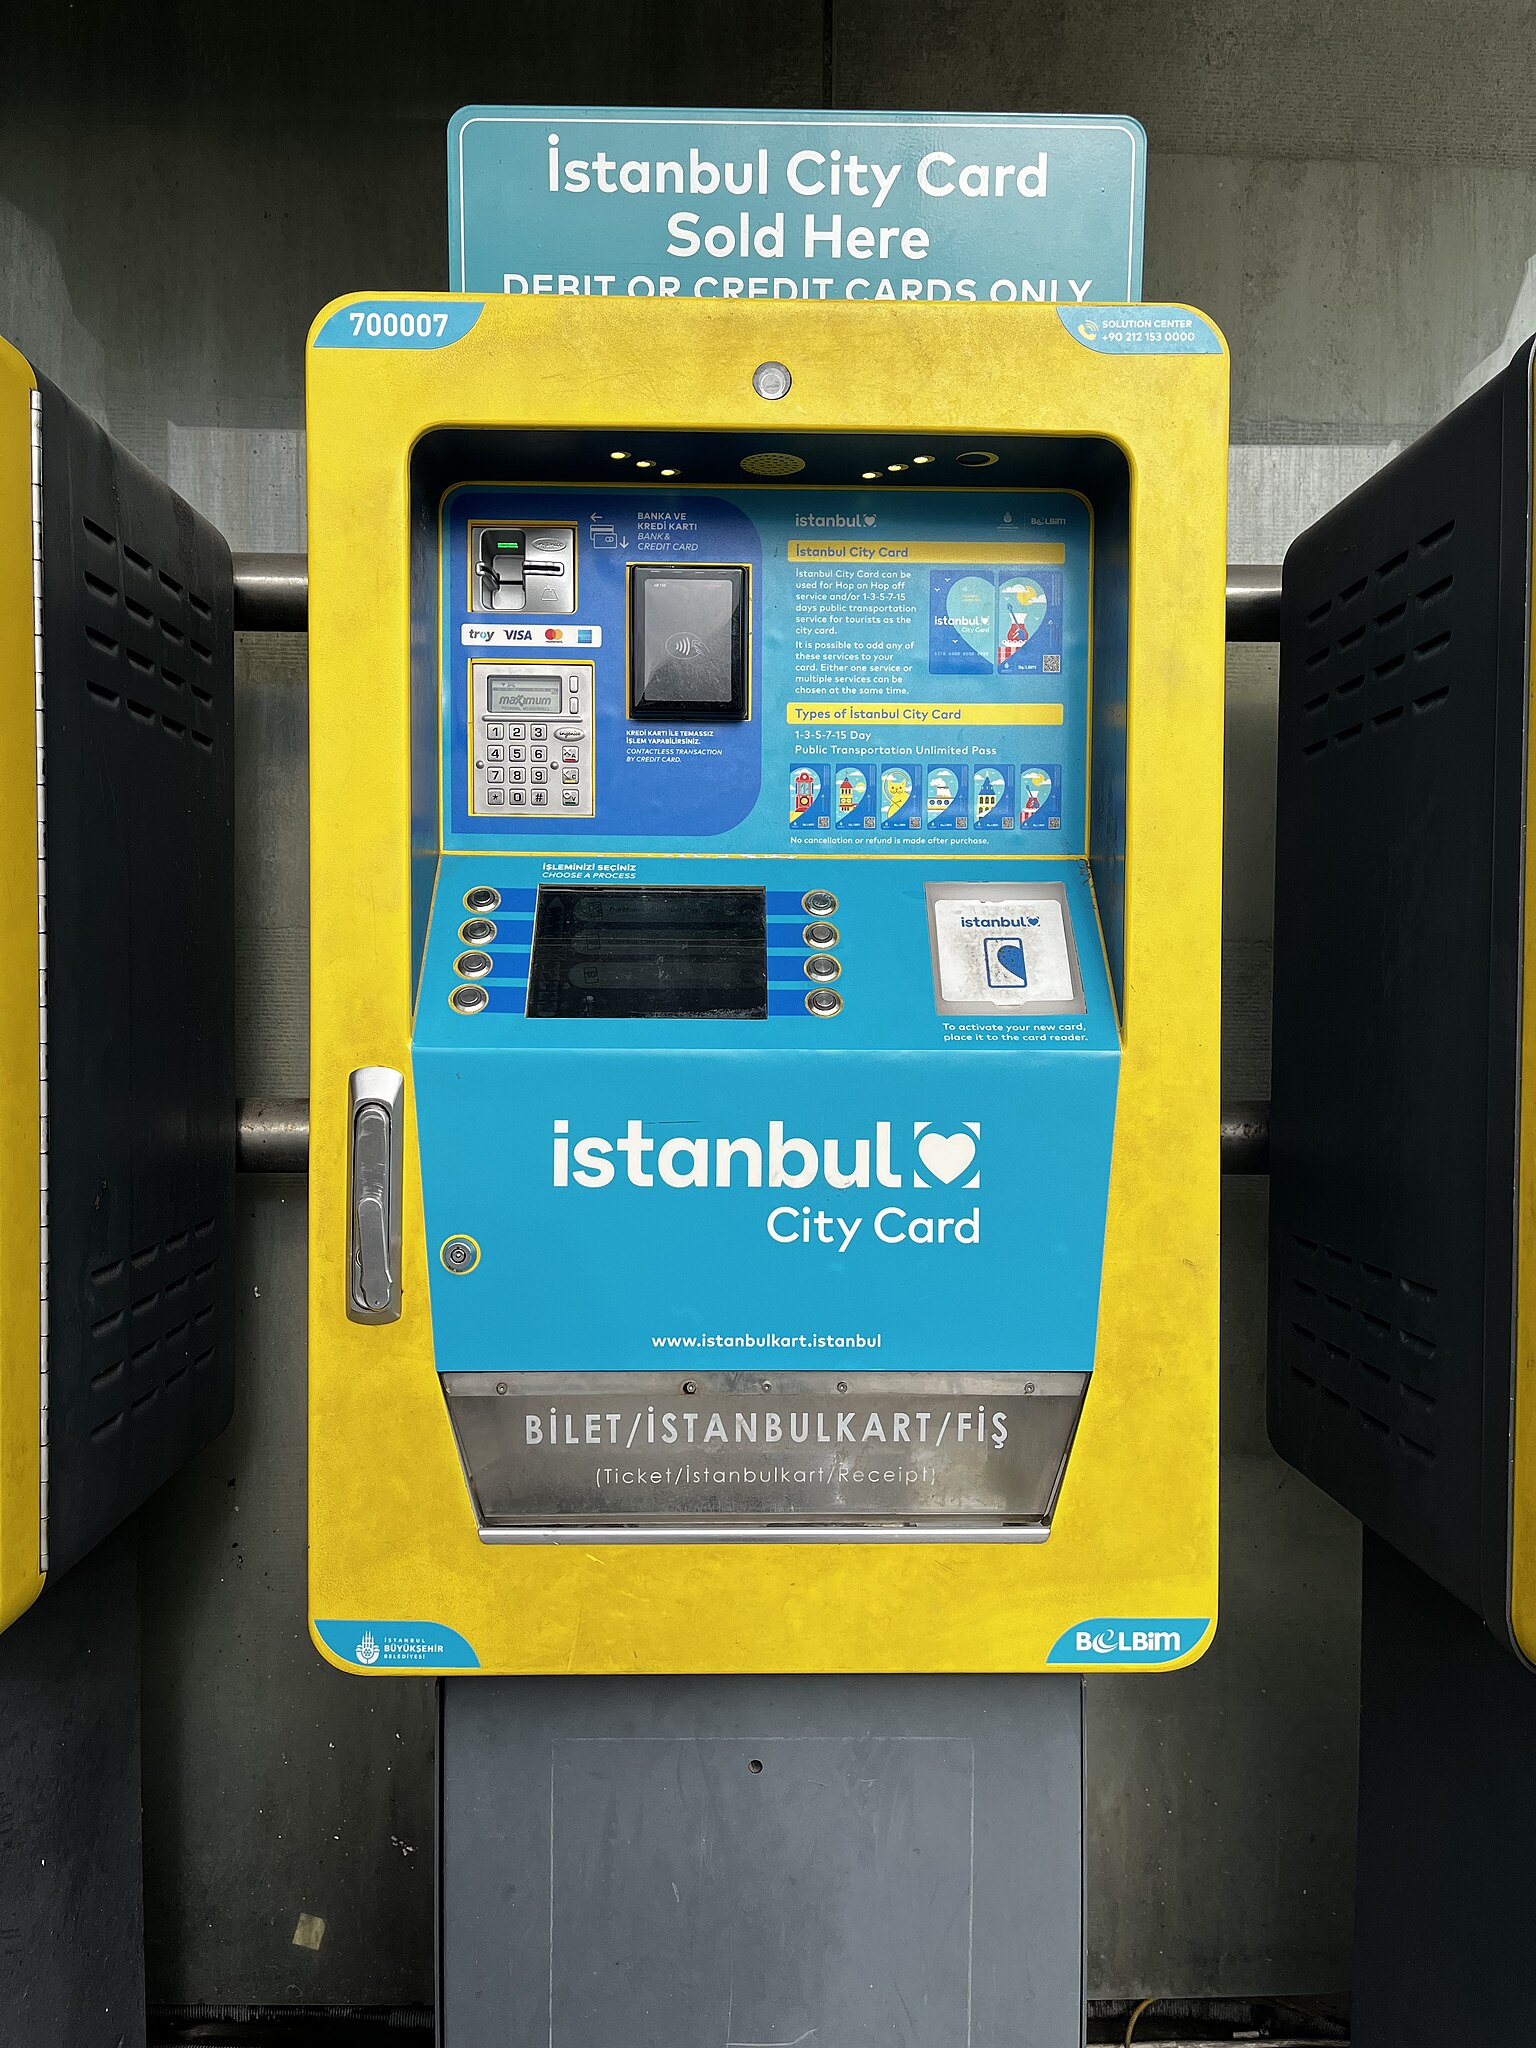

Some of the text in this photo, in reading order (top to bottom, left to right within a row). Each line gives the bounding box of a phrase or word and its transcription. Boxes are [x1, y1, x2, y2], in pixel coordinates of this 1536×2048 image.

[547, 133, 1047, 208] İstanbul City Card
[666, 212, 930, 260] Sold Here
[503, 274, 616, 295] DEBIT
[627, 276, 680, 297] OR
[694, 276, 834, 300] CREDIT
[845, 279, 977, 301] CARDS
[350, 313, 448, 337] 700007
[1102, 319, 1192, 328] SOLUTION CENTER
[1102, 332, 1195, 342] +90 212 153 0000
[637, 512, 687, 521] BANKA VE
[795, 513, 861, 527] istanbul
[637, 520, 698, 531] KREDİ KARTI
[637, 532, 662, 540] BANK
[637, 542, 698, 551] CREDIT CARD
[796, 543, 909, 559] İstanbul City Card
[795, 568, 833, 578] İstanbul
[835, 569, 854, 579] City
[857, 569, 879, 578] Card
[900, 570, 912, 579] be
[795, 581, 817, 589] used
[820, 581, 833, 589] for
[835, 581, 855, 590] Hop
[870, 581, 890, 591] Hop
[892, 581, 905, 590] off
[795, 592, 906, 601] service and/or 1-3-5-7-15
[795, 604, 917, 613] days public transportation
[795, 615, 827, 623] service
[829, 615, 843, 623] for
[845, 616, 881, 624] tourists
[896, 616, 912, 624] the
[934, 616, 979, 626] istanbul
[469, 628, 532, 642] troy VISA
[795, 626, 838, 636] city card.
[795, 641, 803, 649] It
[805, 641, 813, 649] is
[814, 641, 852, 650] possible
[866, 641, 884, 649] add
[886, 643, 902, 651] any
[904, 641, 915, 649] of
[795, 652, 820, 660] these
[873, 654, 894, 662] your
[795, 663, 818, 671] card.
[820, 663, 848, 671] Either
[869, 664, 901, 672] service
[795, 675, 832, 684] multiple
[835, 675, 871, 683] services
[891, 675, 903, 683] be
[795, 686, 827, 694] chosen
[829, 686, 839, 694] at
[841, 686, 856, 694] the
[886, 686, 909, 695] time.
[795, 706, 961, 721] Types of İstanbul City Card
[492, 727, 543, 737] 1 2 3
[626, 729, 646, 737] KREDİ
[669, 729, 678, 737] İLE
[795, 730, 871, 741] 1-3-5-7-15 Day
[626, 737, 646, 746] İŞLEM
[491, 749, 543, 759] 4 5 6
[677, 748, 722, 756] TRANSACTION
[795, 745, 996, 757] Public Transportation Unlimited Pass
[491, 771, 543, 781] 7 8 9
[513, 793, 521, 802] 0
[804, 837, 853, 845] cancellation
[866, 837, 891, 845] refund
[893, 837, 901, 845] is
[903, 837, 926, 845] made
[928, 837, 948, 845] after
[950, 838, 989, 846] purchase.
[543, 862, 636, 873] İŞLEMİNİZİ SEÇİNİZ
[961, 917, 1027, 928] istanbul
[943, 1023, 956, 1031] To
[959, 1023, 1004, 1031] activate
[1006, 1024, 1031, 1033] your
[1058, 1023, 1087, 1032] card,
[944, 1034, 973, 1042] place
[553, 1119, 902, 1189] istanbul
[766, 1205, 980, 1253] City Card
[651, 1333, 882, 1348] www.istanbulkart.istanbul
[383, 1643, 444, 1653] BÜYÜKŞEHİR
